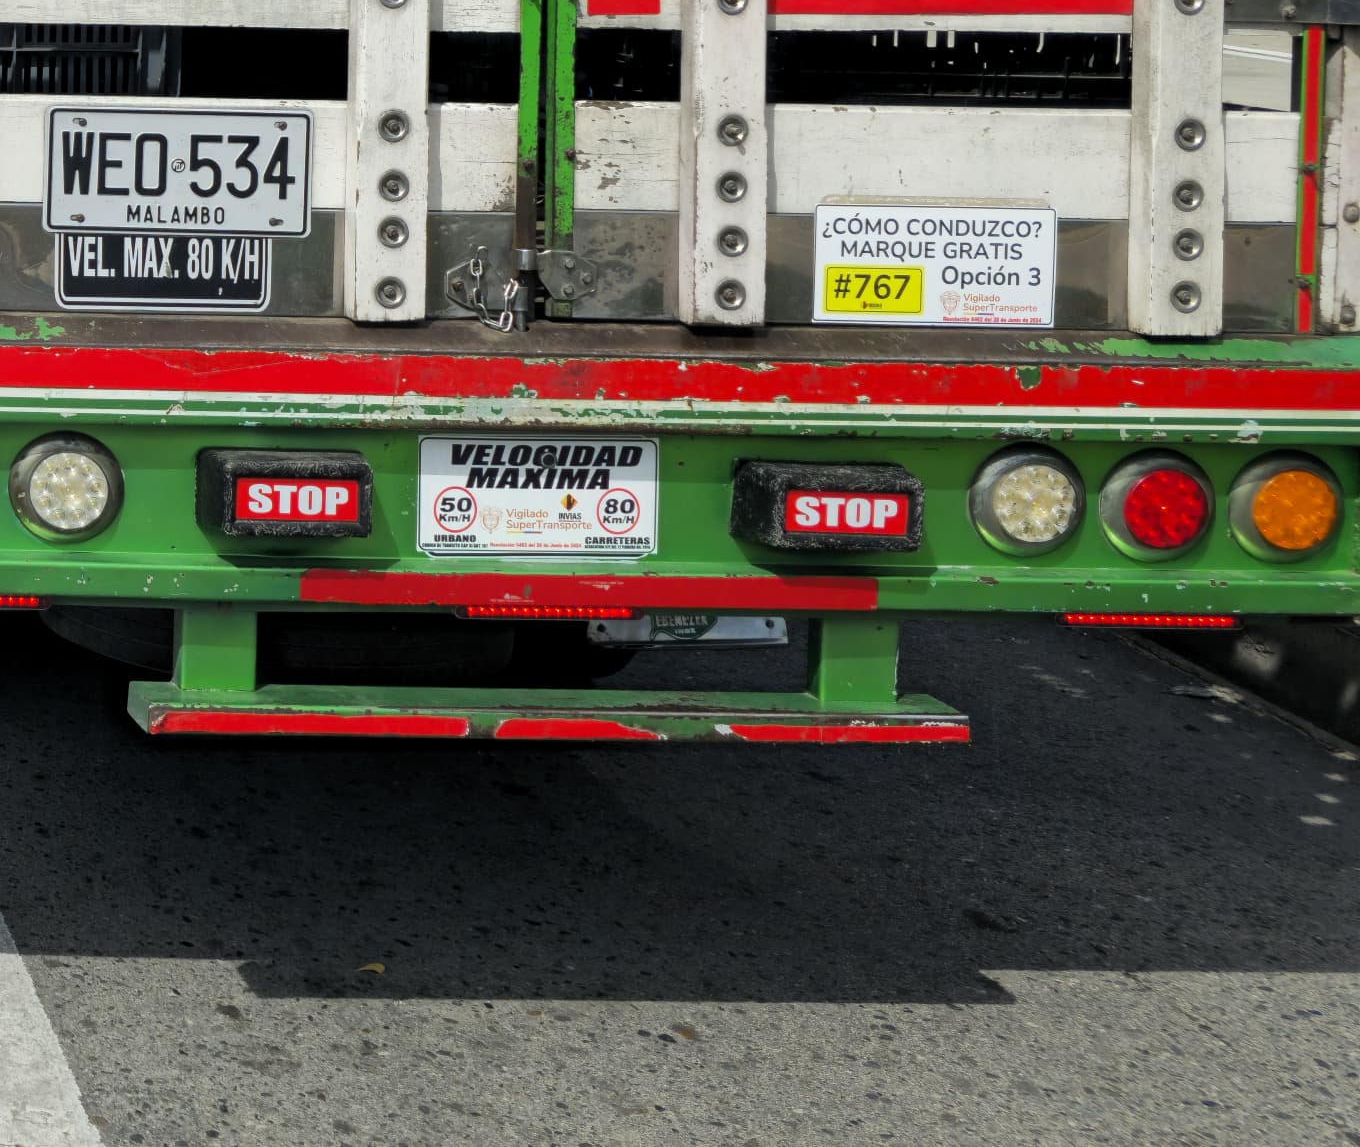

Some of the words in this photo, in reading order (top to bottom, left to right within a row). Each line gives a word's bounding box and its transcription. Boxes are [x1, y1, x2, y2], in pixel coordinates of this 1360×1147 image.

[127, 205, 225, 225] MALAMBO
[822, 213, 899, 238] ¿CÓMO
[906, 218, 1042, 239] CONDUZCO?
[67, 236, 115, 277] VEL.
[123, 237, 179, 278] MAX.
[187, 238, 214, 280] 80
[221, 238, 259, 283] K/H
[840, 241, 935, 262] MARQUE
[943, 242, 1023, 260] GRATIS
[941, 265, 1020, 289] Opción
[1028, 267, 1041, 286] 3
[834, 273, 911, 300] #767
[963, 293, 1000, 303] Vigilado
[963, 303, 1038, 313] SuperTransporte
[451, 443, 643, 467] VELOCIDAD
[465, 468, 610, 490] MAXIMA
[248, 484, 349, 515] STOP
[440, 497, 472, 513] 50
[604, 498, 635, 514] 80
[438, 514, 471, 524] Km/H
[506, 509, 549, 519] Vigilado
[558, 512, 582, 520] INVIAS
[602, 515, 635, 525] Km/H
[795, 496, 898, 528] STOP
[506, 520, 592, 532] SuperTransporte
[434, 534, 477, 543] URBANO
[585, 536, 650, 545] CARRETERAS
